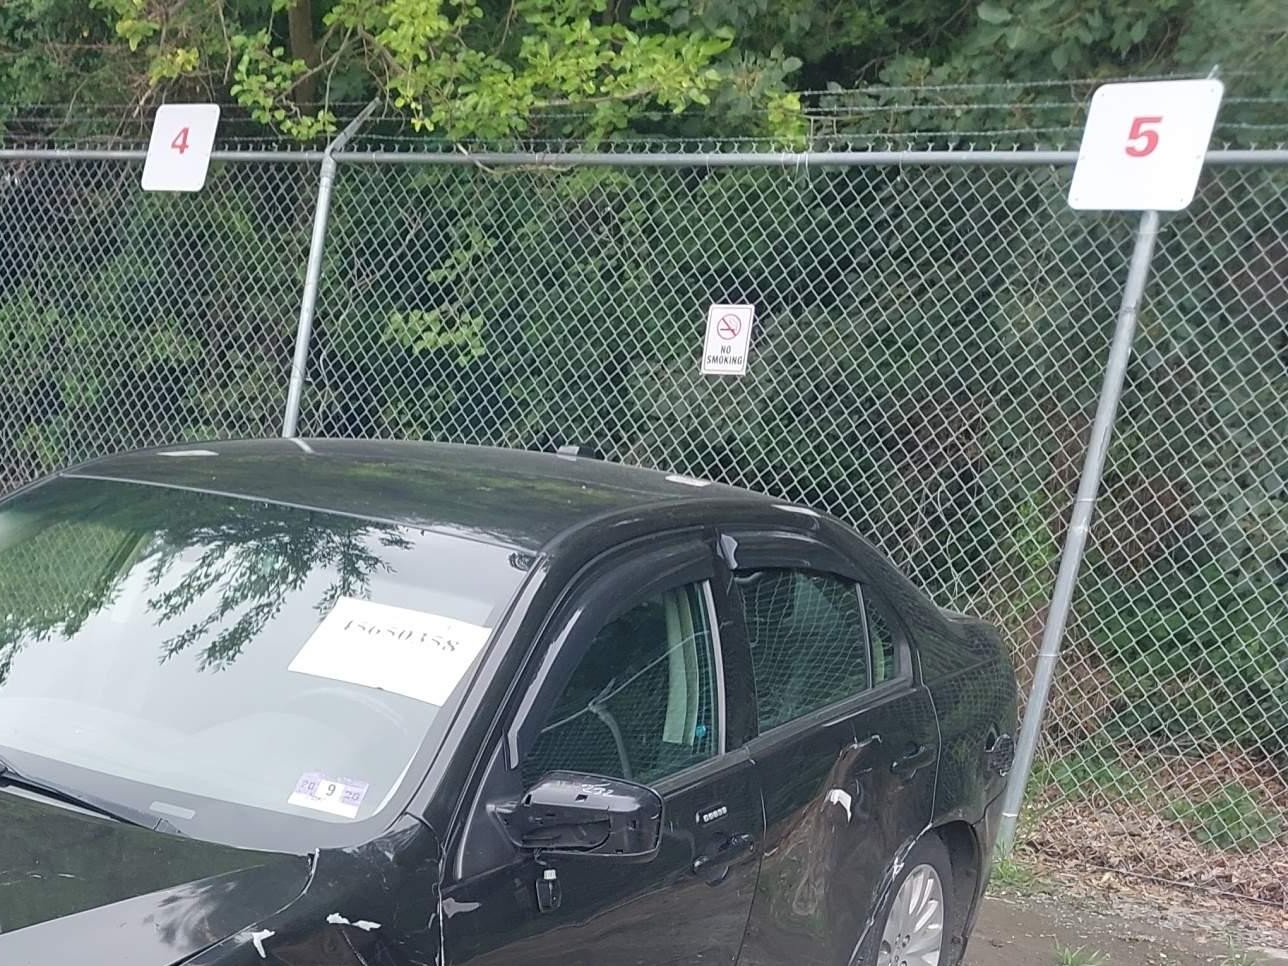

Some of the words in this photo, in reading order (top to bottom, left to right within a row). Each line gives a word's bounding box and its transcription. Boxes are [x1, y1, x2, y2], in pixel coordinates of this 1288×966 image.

[171, 127, 190, 155] 4
[1125, 116, 1163, 158] 5
[720, 345, 732, 354] NO
[706, 355, 743, 365] SMOKING
[326, 783, 337, 797] 9
